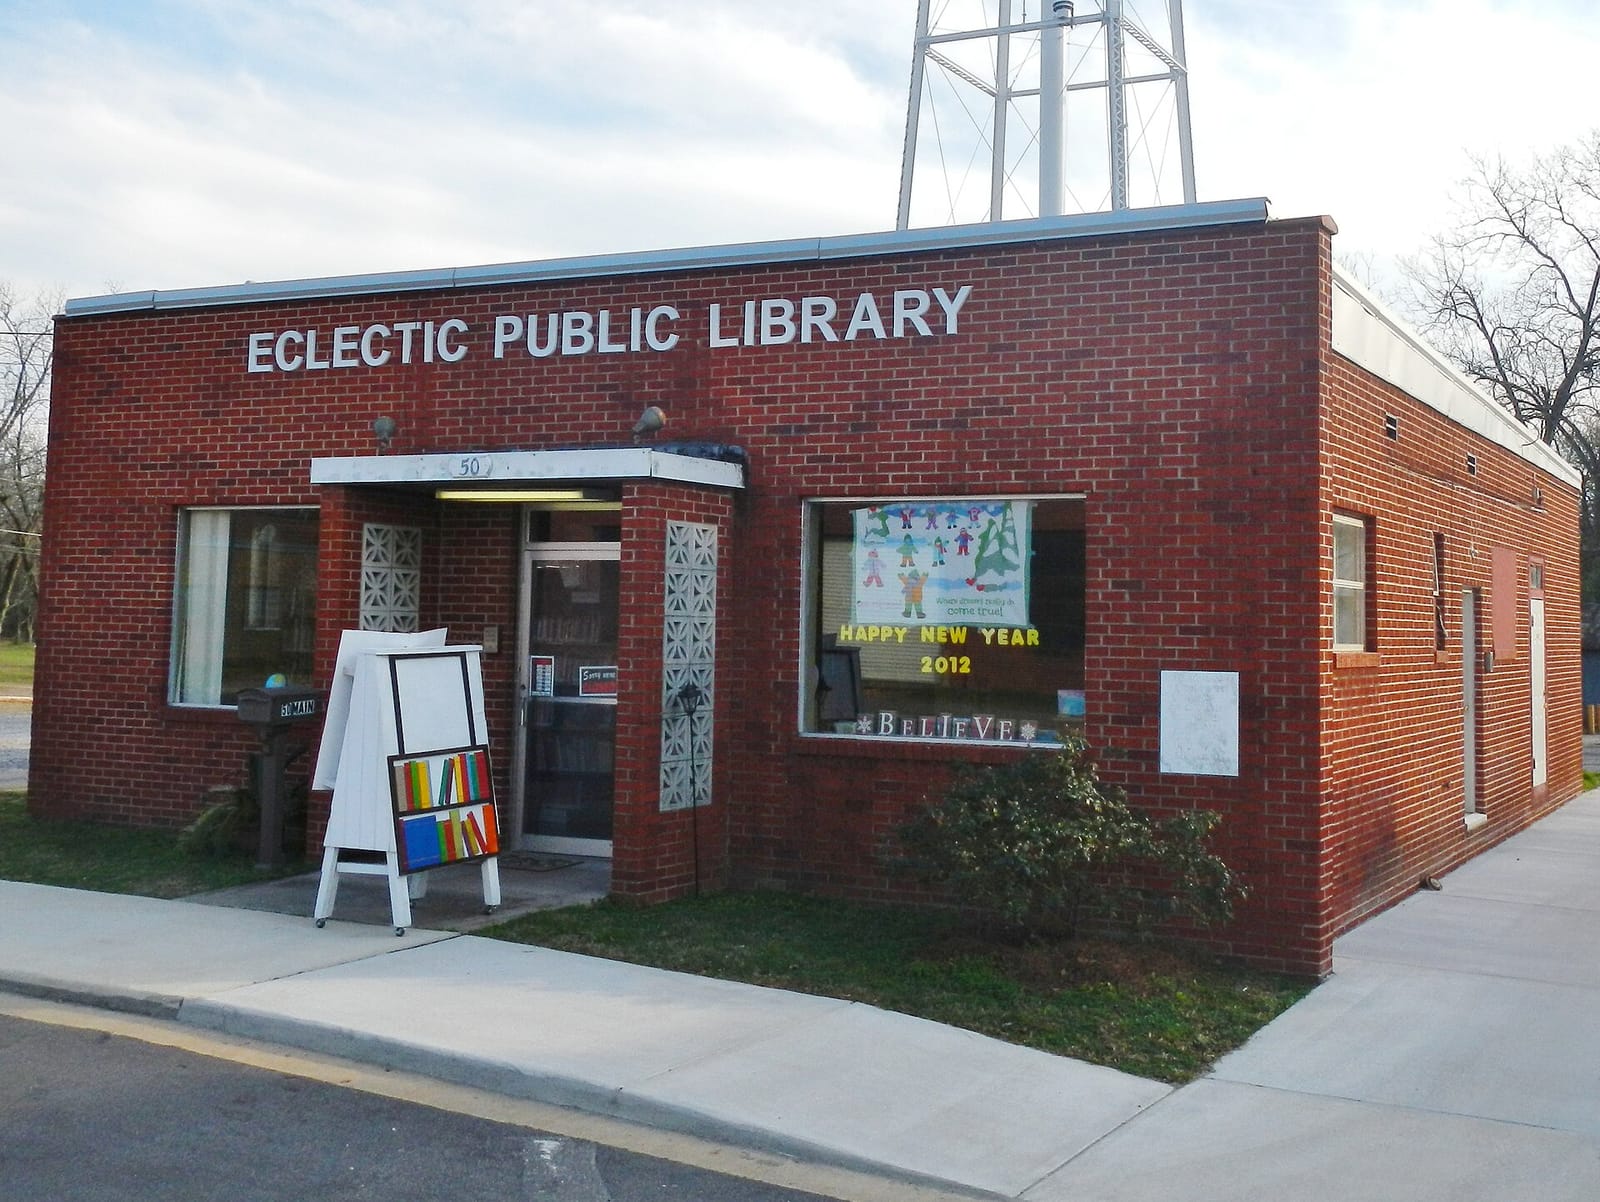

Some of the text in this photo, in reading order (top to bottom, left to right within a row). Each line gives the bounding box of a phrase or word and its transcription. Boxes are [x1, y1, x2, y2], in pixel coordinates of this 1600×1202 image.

[246, 285, 974, 374] ECLECTIC PUBLIC LIBRARY
[459, 457, 480, 476] 50
[946, 607, 975, 616] come
[840, 624, 1040, 647] HAPPY NEW YEAR
[920, 655, 972, 675] 2012
